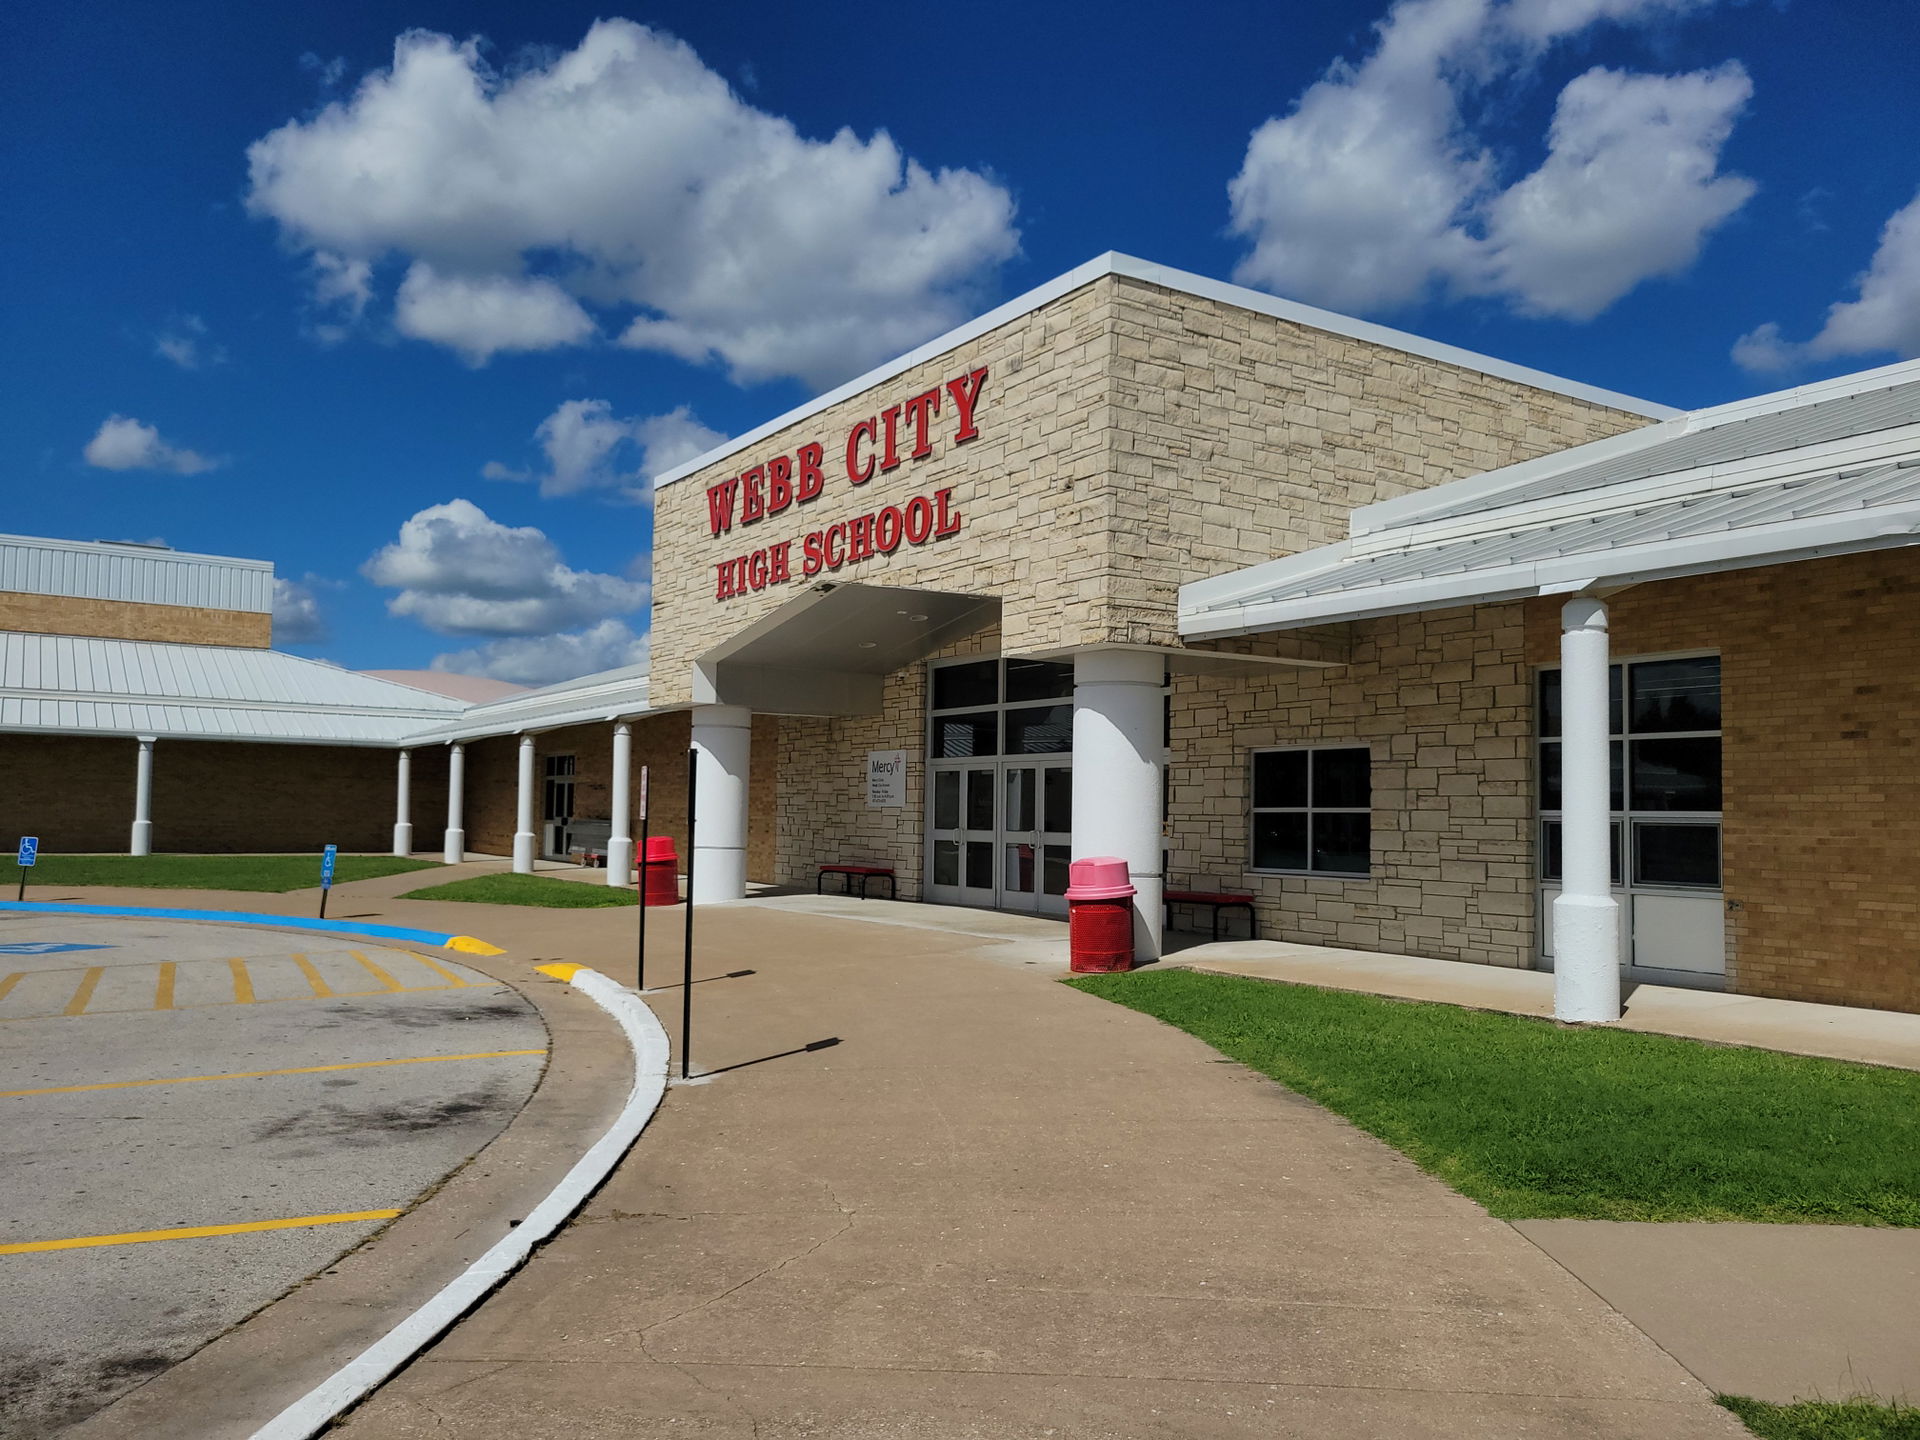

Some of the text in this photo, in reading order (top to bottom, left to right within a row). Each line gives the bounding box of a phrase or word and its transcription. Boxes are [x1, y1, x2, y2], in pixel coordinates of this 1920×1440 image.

[706, 366, 988, 534] WEBB CITY
[716, 488, 961, 599] HIGH SCHOOL
[872, 760, 895, 775] Mercy
